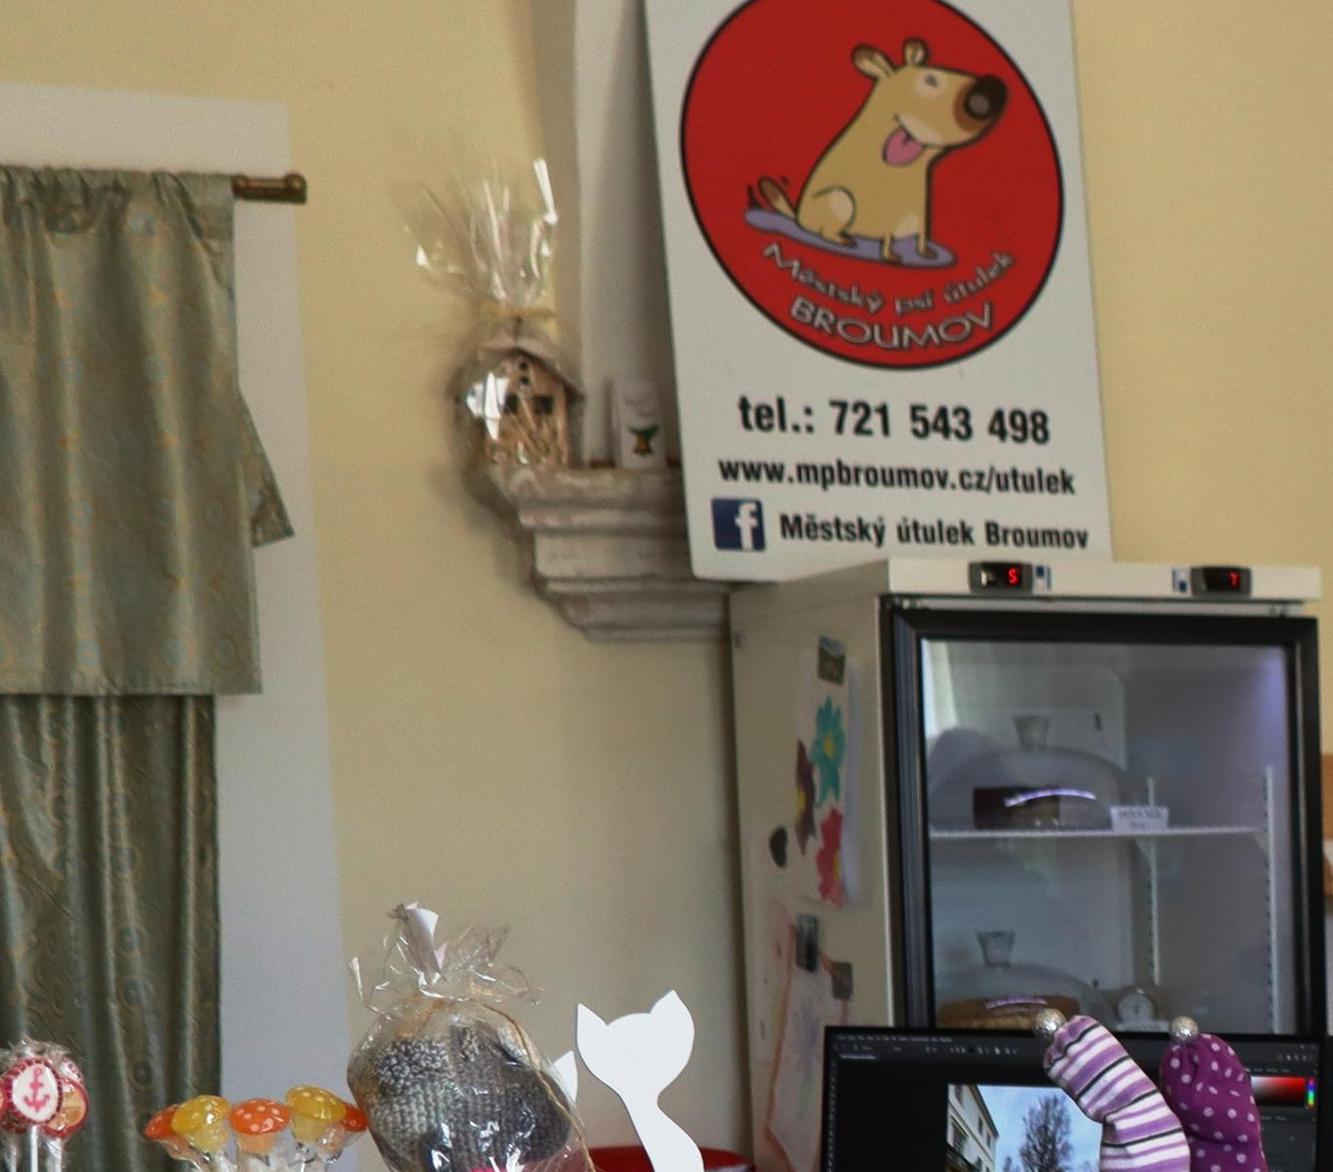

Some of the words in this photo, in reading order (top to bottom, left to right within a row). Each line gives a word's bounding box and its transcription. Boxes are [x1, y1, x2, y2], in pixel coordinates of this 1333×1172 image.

[789, 293, 995, 351] BROUMOV
[736, 394, 814, 434] tel.:
[827, 398, 890, 438] 721
[908, 402, 973, 442] 543
[986, 407, 1050, 445] 498
[716, 457, 1075, 495] www.mpbroumov.cz/utulek
[778, 512, 886, 549] Městský
[895, 516, 975, 546] útulek
[983, 519, 1089, 550] Broumov
